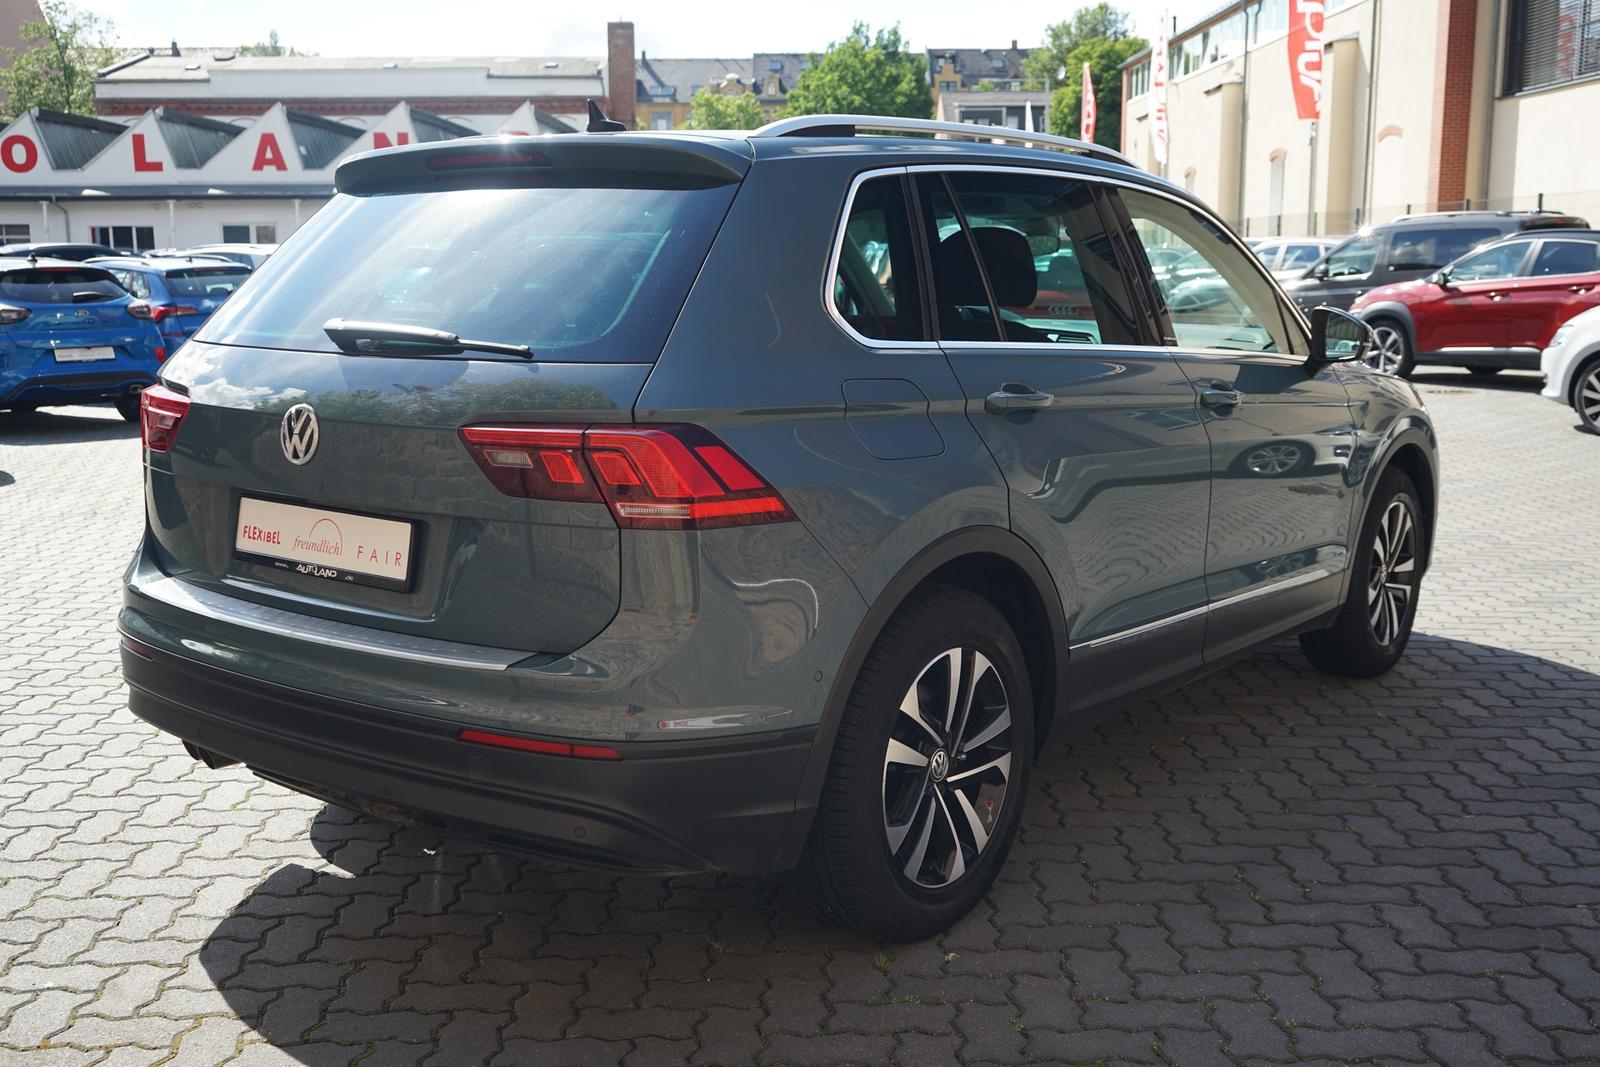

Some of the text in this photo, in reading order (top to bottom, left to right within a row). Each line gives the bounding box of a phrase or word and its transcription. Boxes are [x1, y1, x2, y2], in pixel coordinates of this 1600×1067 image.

[281, 403, 319, 466] VW
[242, 525, 402, 567] FLEXIBEL freundlich FAIR
[296, 564, 338, 578] AUTOLAND
